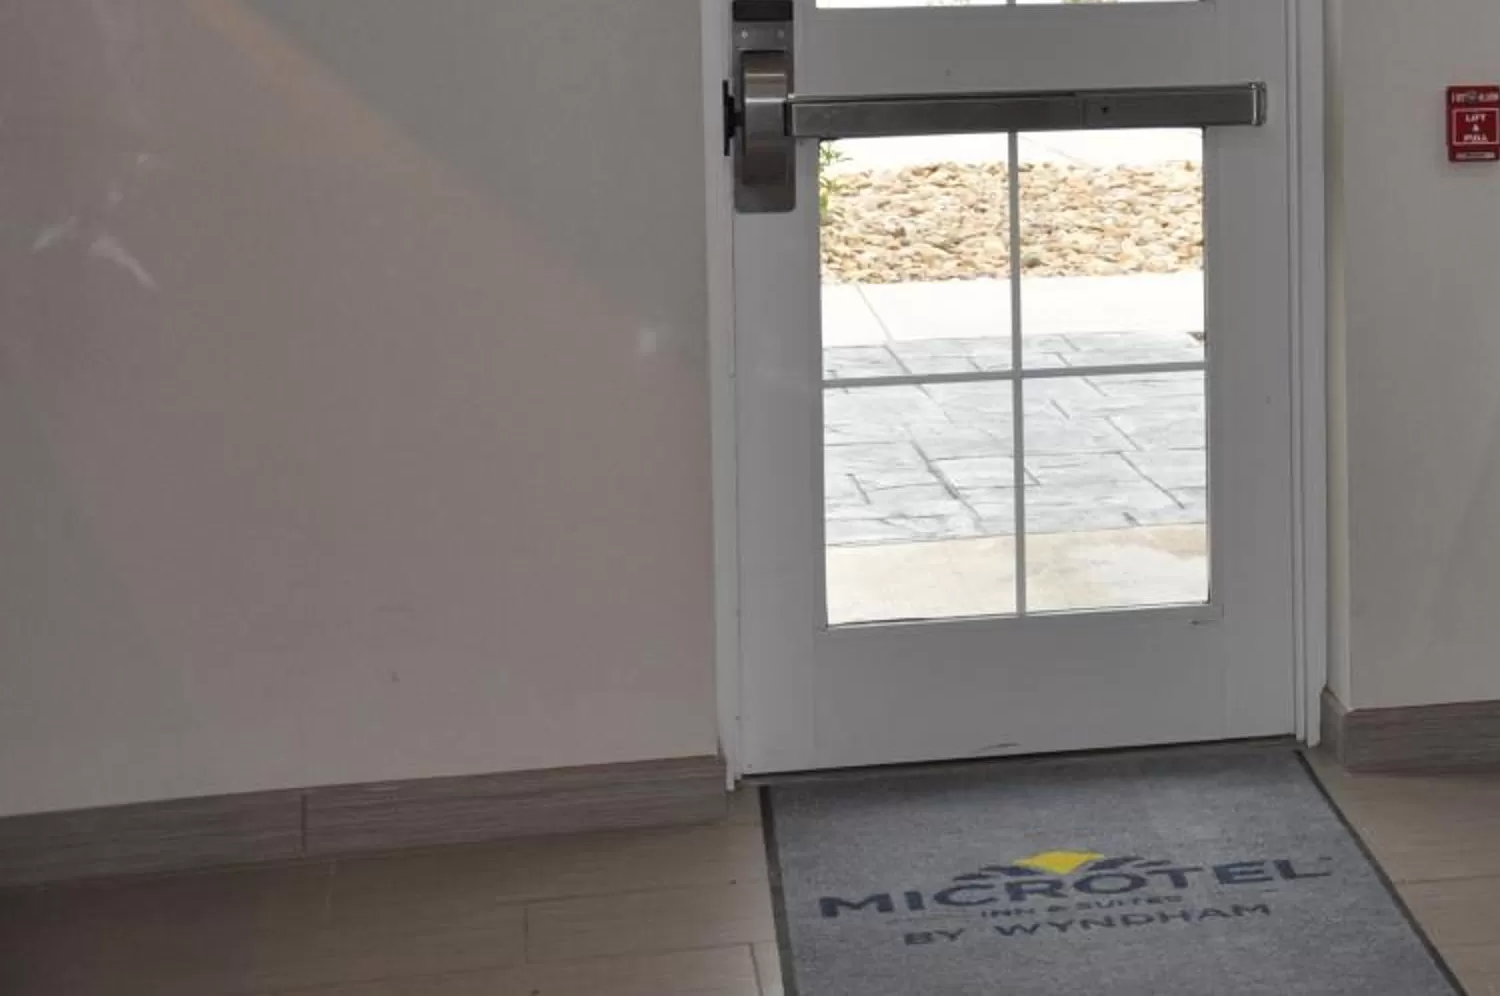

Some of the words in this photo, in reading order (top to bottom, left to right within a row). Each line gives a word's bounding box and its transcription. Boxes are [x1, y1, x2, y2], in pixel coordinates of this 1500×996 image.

[819, 859, 1333, 918] MICROTEL
[904, 927, 965, 946] BY
[993, 903, 1272, 937] WYNDHAM
